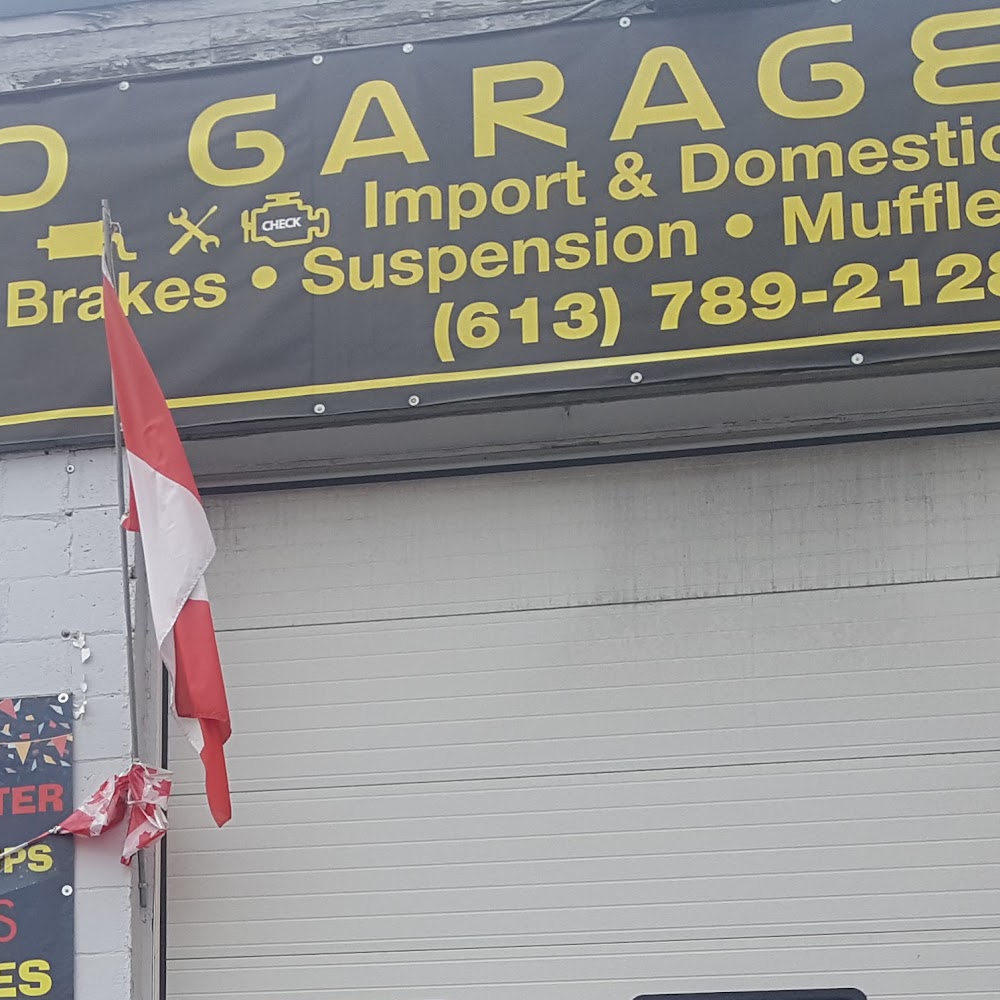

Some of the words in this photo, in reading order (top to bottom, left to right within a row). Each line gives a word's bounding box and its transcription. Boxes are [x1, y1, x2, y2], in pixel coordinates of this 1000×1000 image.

[188, 8, 1000, 187] GARAGE
[261, 216, 302, 231] CHECK
[364, 161, 587, 235] Import
[608, 151, 658, 201] &
[6, 270, 228, 328] Brakes
[301, 217, 698, 295] Suspension
[433, 286, 622, 363] (613)
[651, 251, 1000, 331] 789-212
